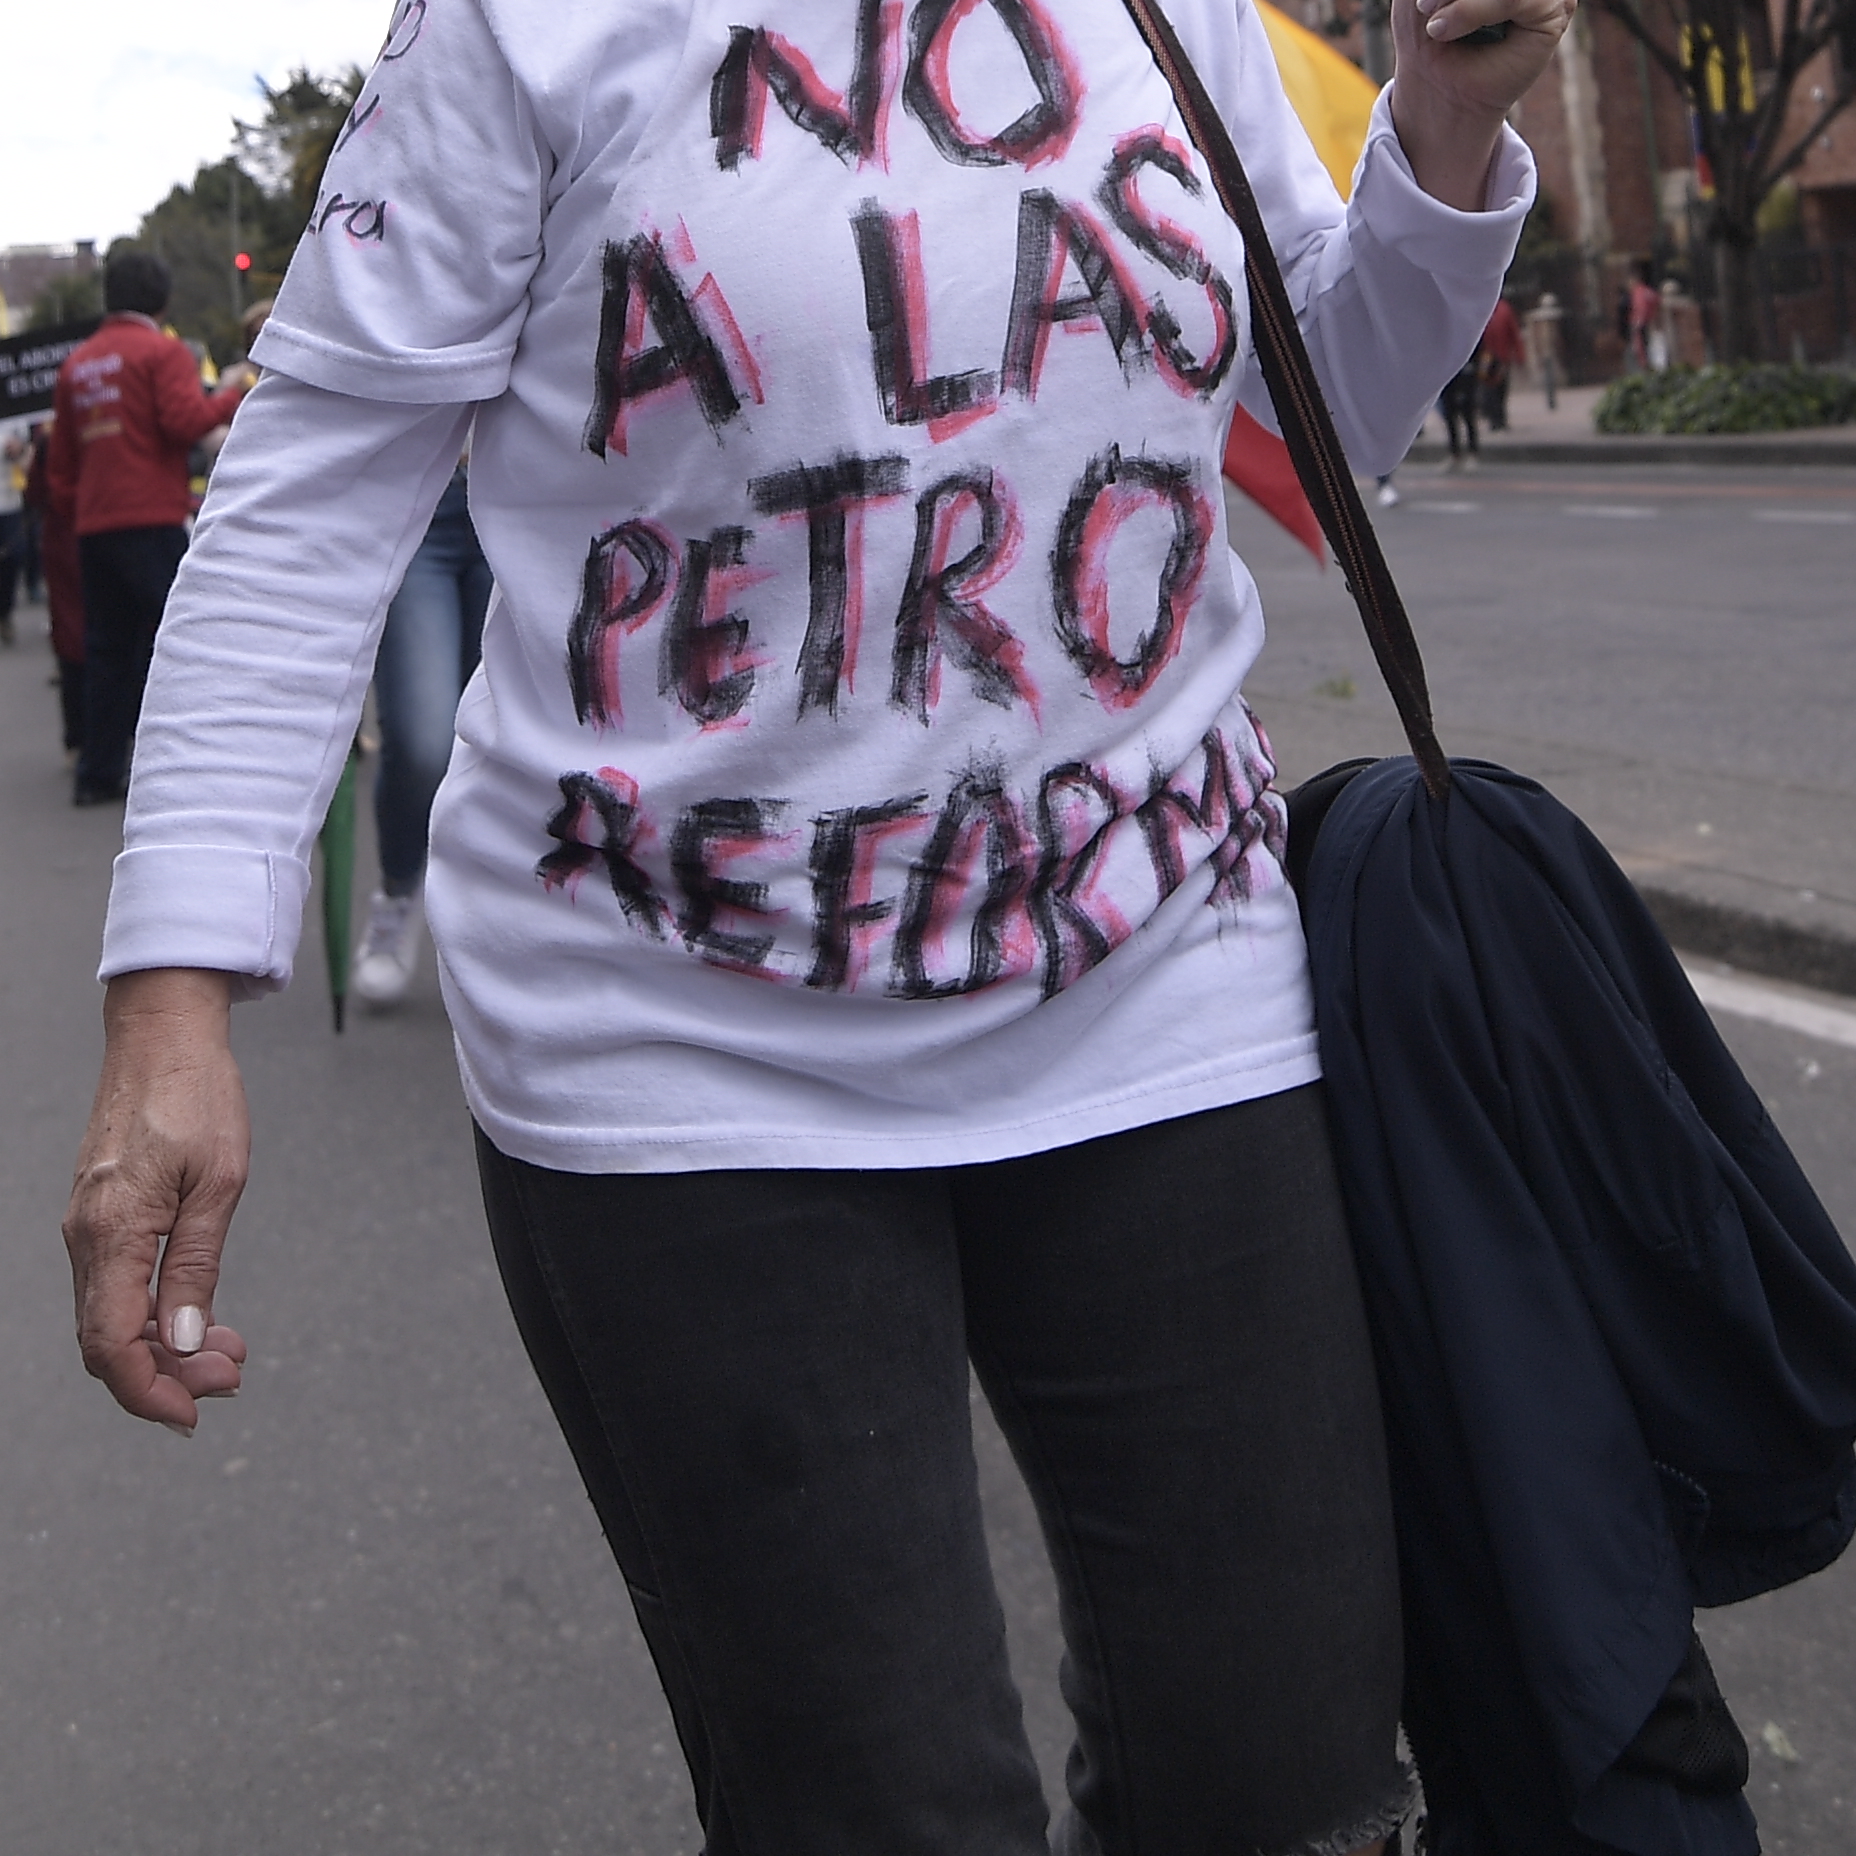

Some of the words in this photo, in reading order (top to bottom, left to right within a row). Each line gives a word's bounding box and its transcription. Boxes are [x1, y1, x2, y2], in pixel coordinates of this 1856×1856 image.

[20, 343, 82, 369] ABORT
[581, 214, 764, 462] A
[849, 123, 1237, 443] LAS
[565, 443, 1217, 732] PETRO
